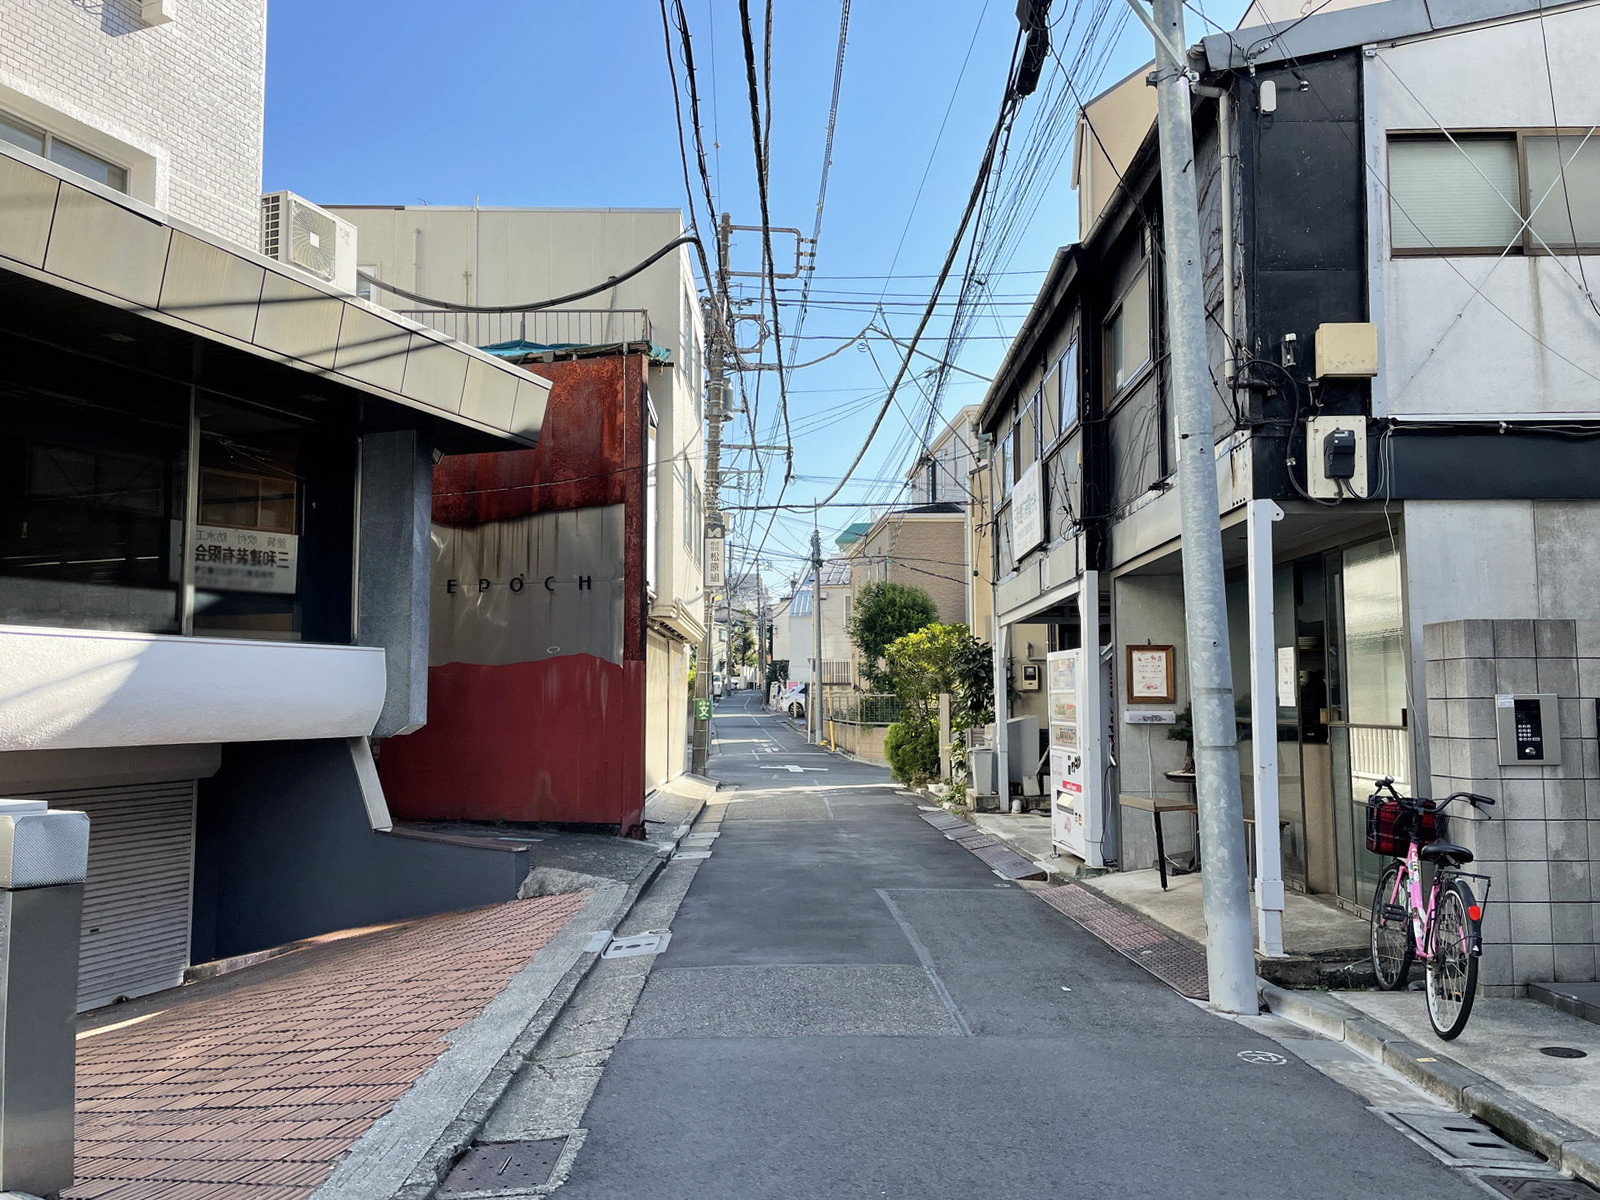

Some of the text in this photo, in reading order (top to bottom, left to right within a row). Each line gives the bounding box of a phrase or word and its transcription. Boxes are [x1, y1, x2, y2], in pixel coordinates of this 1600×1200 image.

[710, 552, 720, 582] 松原組
[447, 576, 592, 594] EPOCH
